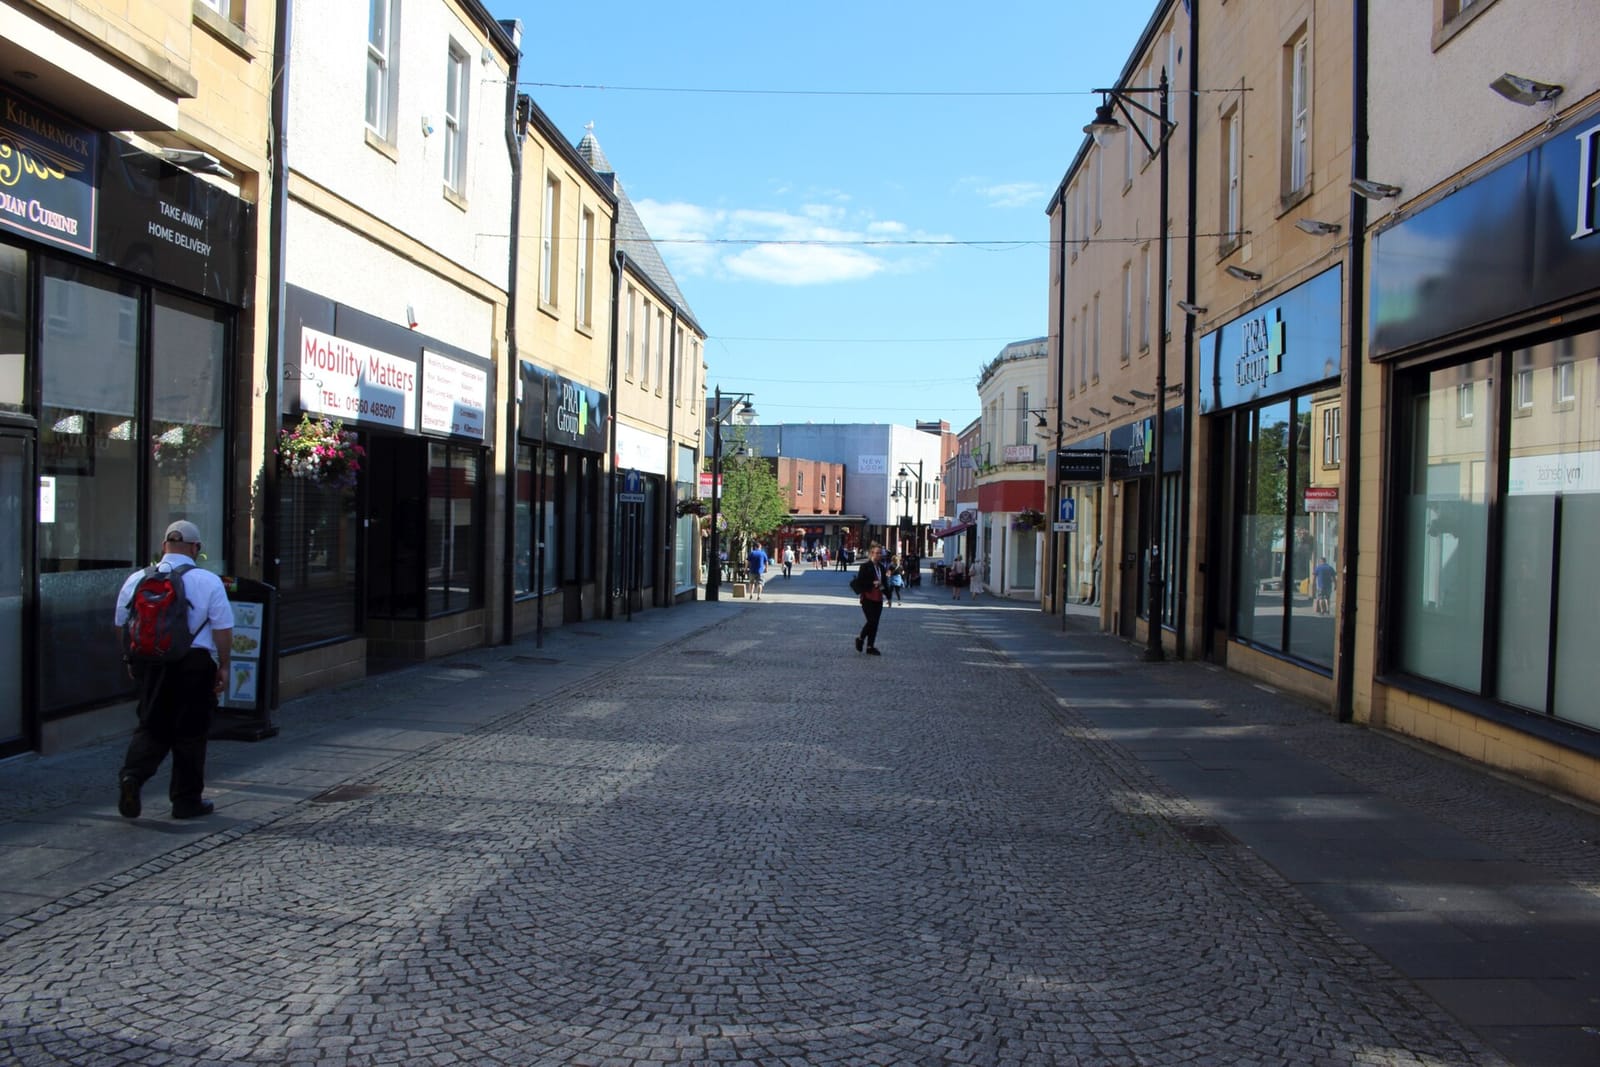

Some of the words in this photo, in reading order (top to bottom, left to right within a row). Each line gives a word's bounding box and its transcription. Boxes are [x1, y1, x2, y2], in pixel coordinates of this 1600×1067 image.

[6, 98, 89, 156] KILMARNOCK
[28, 199, 78, 236] CUISINE
[159, 201, 181, 223] TAKE
[181, 210, 204, 231] AWAY
[148, 221, 174, 243] HOME
[175, 229, 211, 257] DELIVERY
[1242, 315, 1269, 357] PRA
[305, 335, 364, 387] Mobility
[369, 355, 414, 392] Matters
[1236, 355, 1269, 388] Group
[322, 390, 341, 409] TEL:
[346, 396, 368, 414] 01560
[370, 400, 396, 420] 485907
[563, 383, 579, 413] PRA
[557, 404, 579, 441] Group
[860, 464, 883, 472] LOOK
